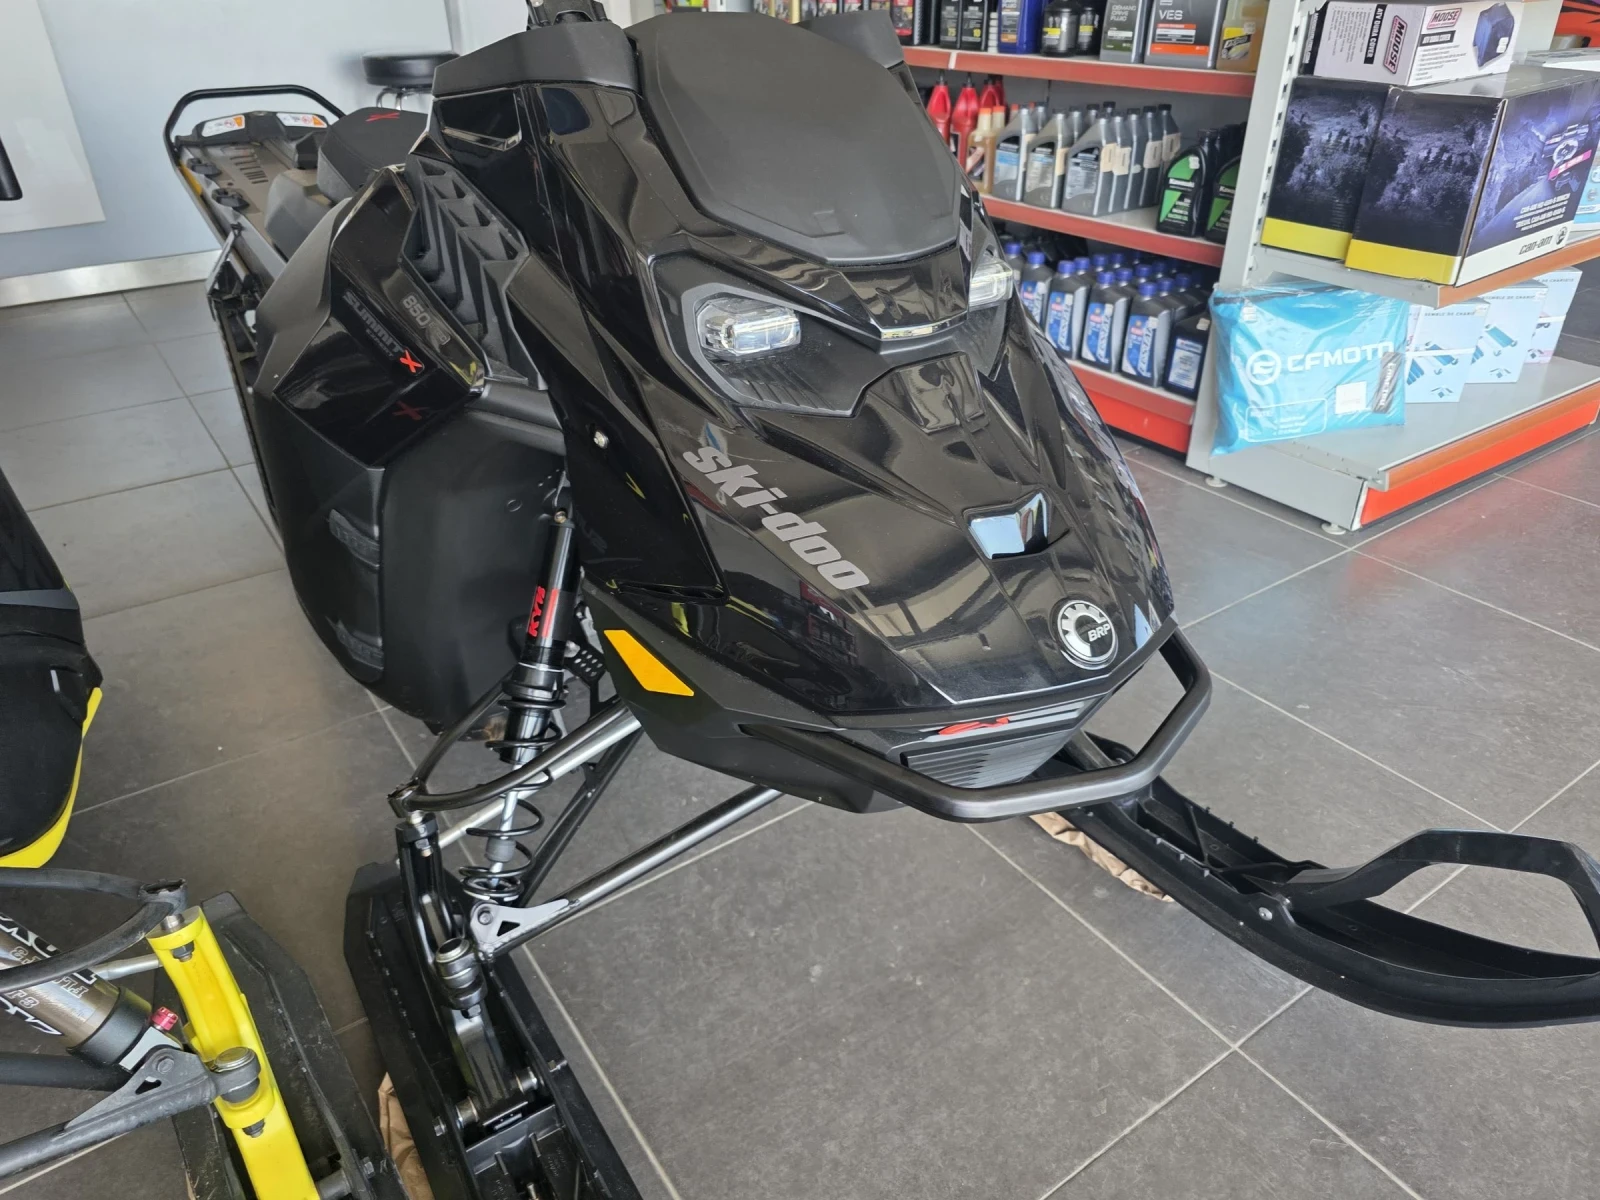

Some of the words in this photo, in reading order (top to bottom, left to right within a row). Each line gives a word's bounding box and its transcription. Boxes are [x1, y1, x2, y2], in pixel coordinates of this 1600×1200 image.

[1159, 10, 1183, 20] VES
[1431, 11, 1459, 22] MOOSE
[1366, 38, 1376, 58] COVER
[1389, 21, 1405, 71] MOOSE
[1519, 235, 1553, 255] can-am
[404, 296, 431, 326] 850
[343, 290, 405, 354] SUMMIT
[400, 348, 423, 373] X
[682, 446, 870, 590] ski-doo
[528, 585, 546, 638] KYB
[1087, 623, 1111, 642] BRP
